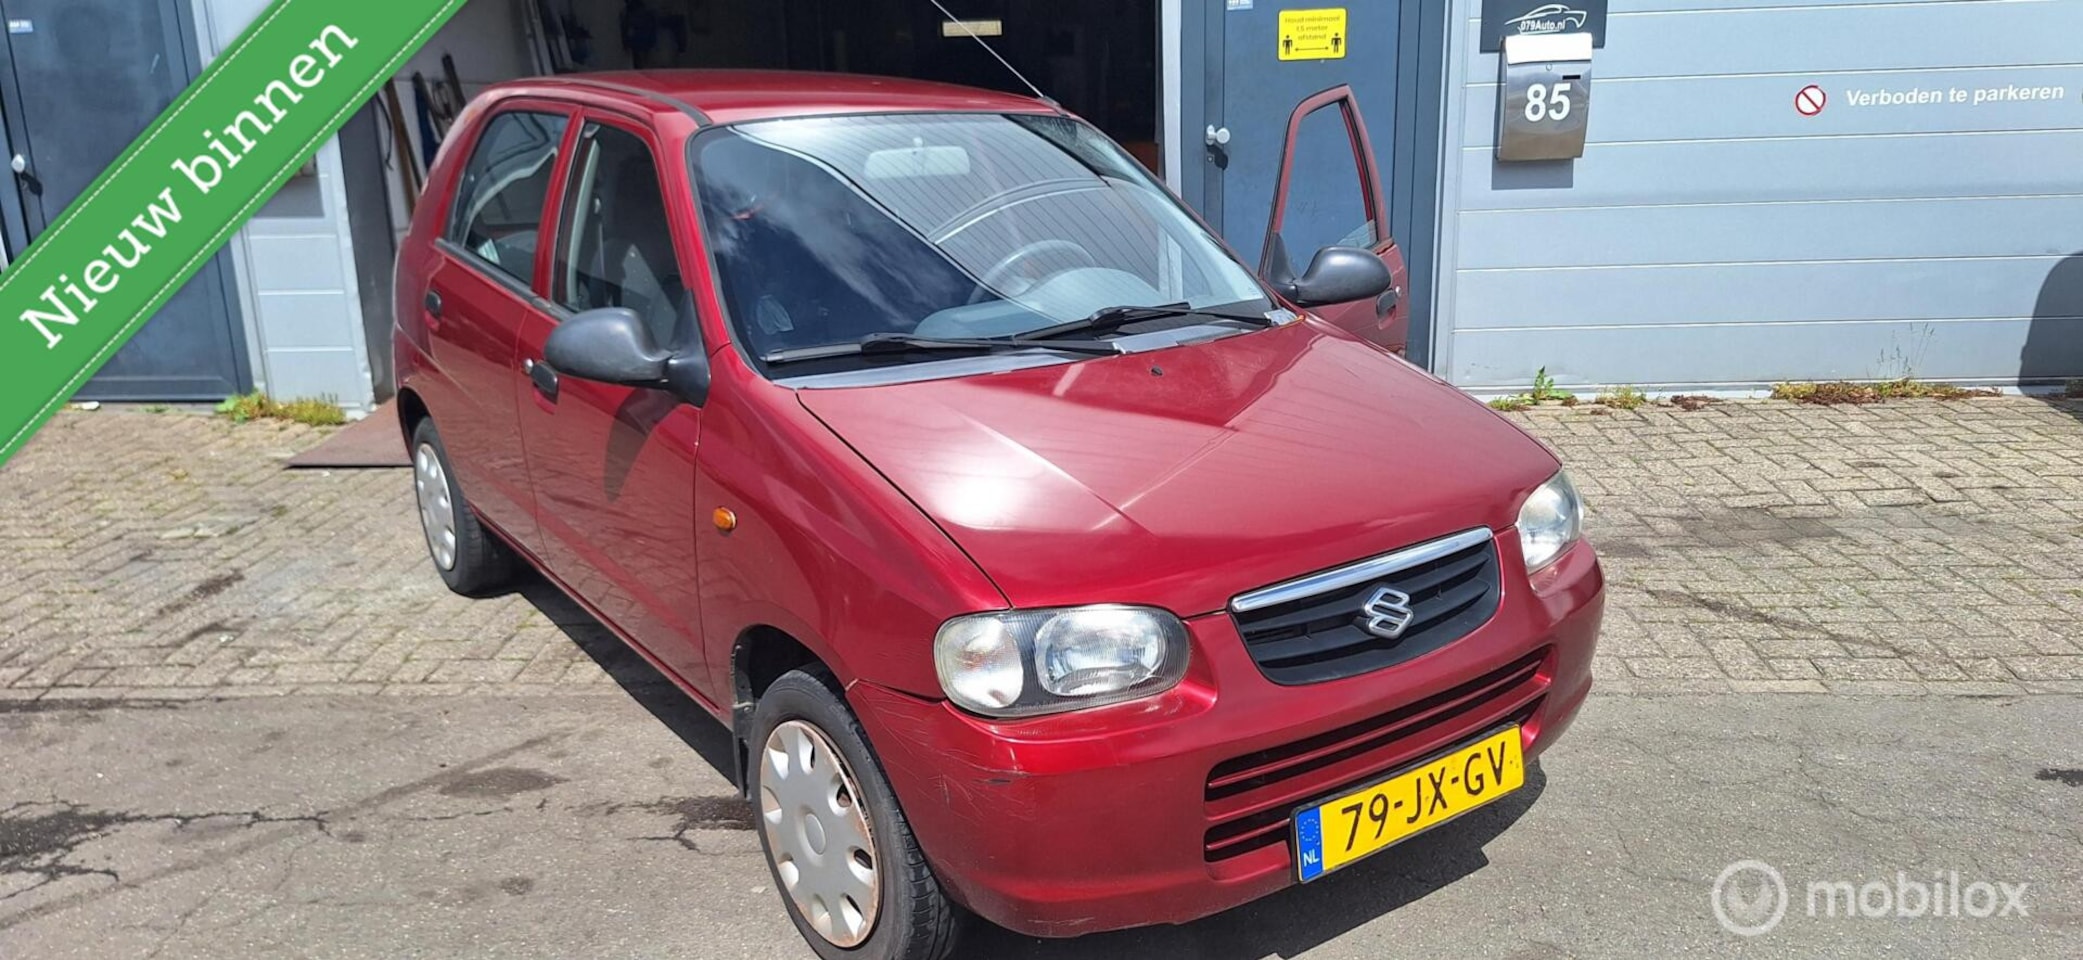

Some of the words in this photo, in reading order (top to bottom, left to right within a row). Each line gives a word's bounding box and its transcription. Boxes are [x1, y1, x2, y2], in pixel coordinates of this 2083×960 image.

[1520, 19, 1566, 31] 079Auto.nl
[1524, 82, 1571, 122] 85
[1846, 88, 1943, 106] Verboden
[1949, 87, 1968, 103] te
[1974, 85, 2065, 105] parkeren
[1341, 741, 1506, 852] 79-JX-GV
[1303, 849, 1319, 867] NL
